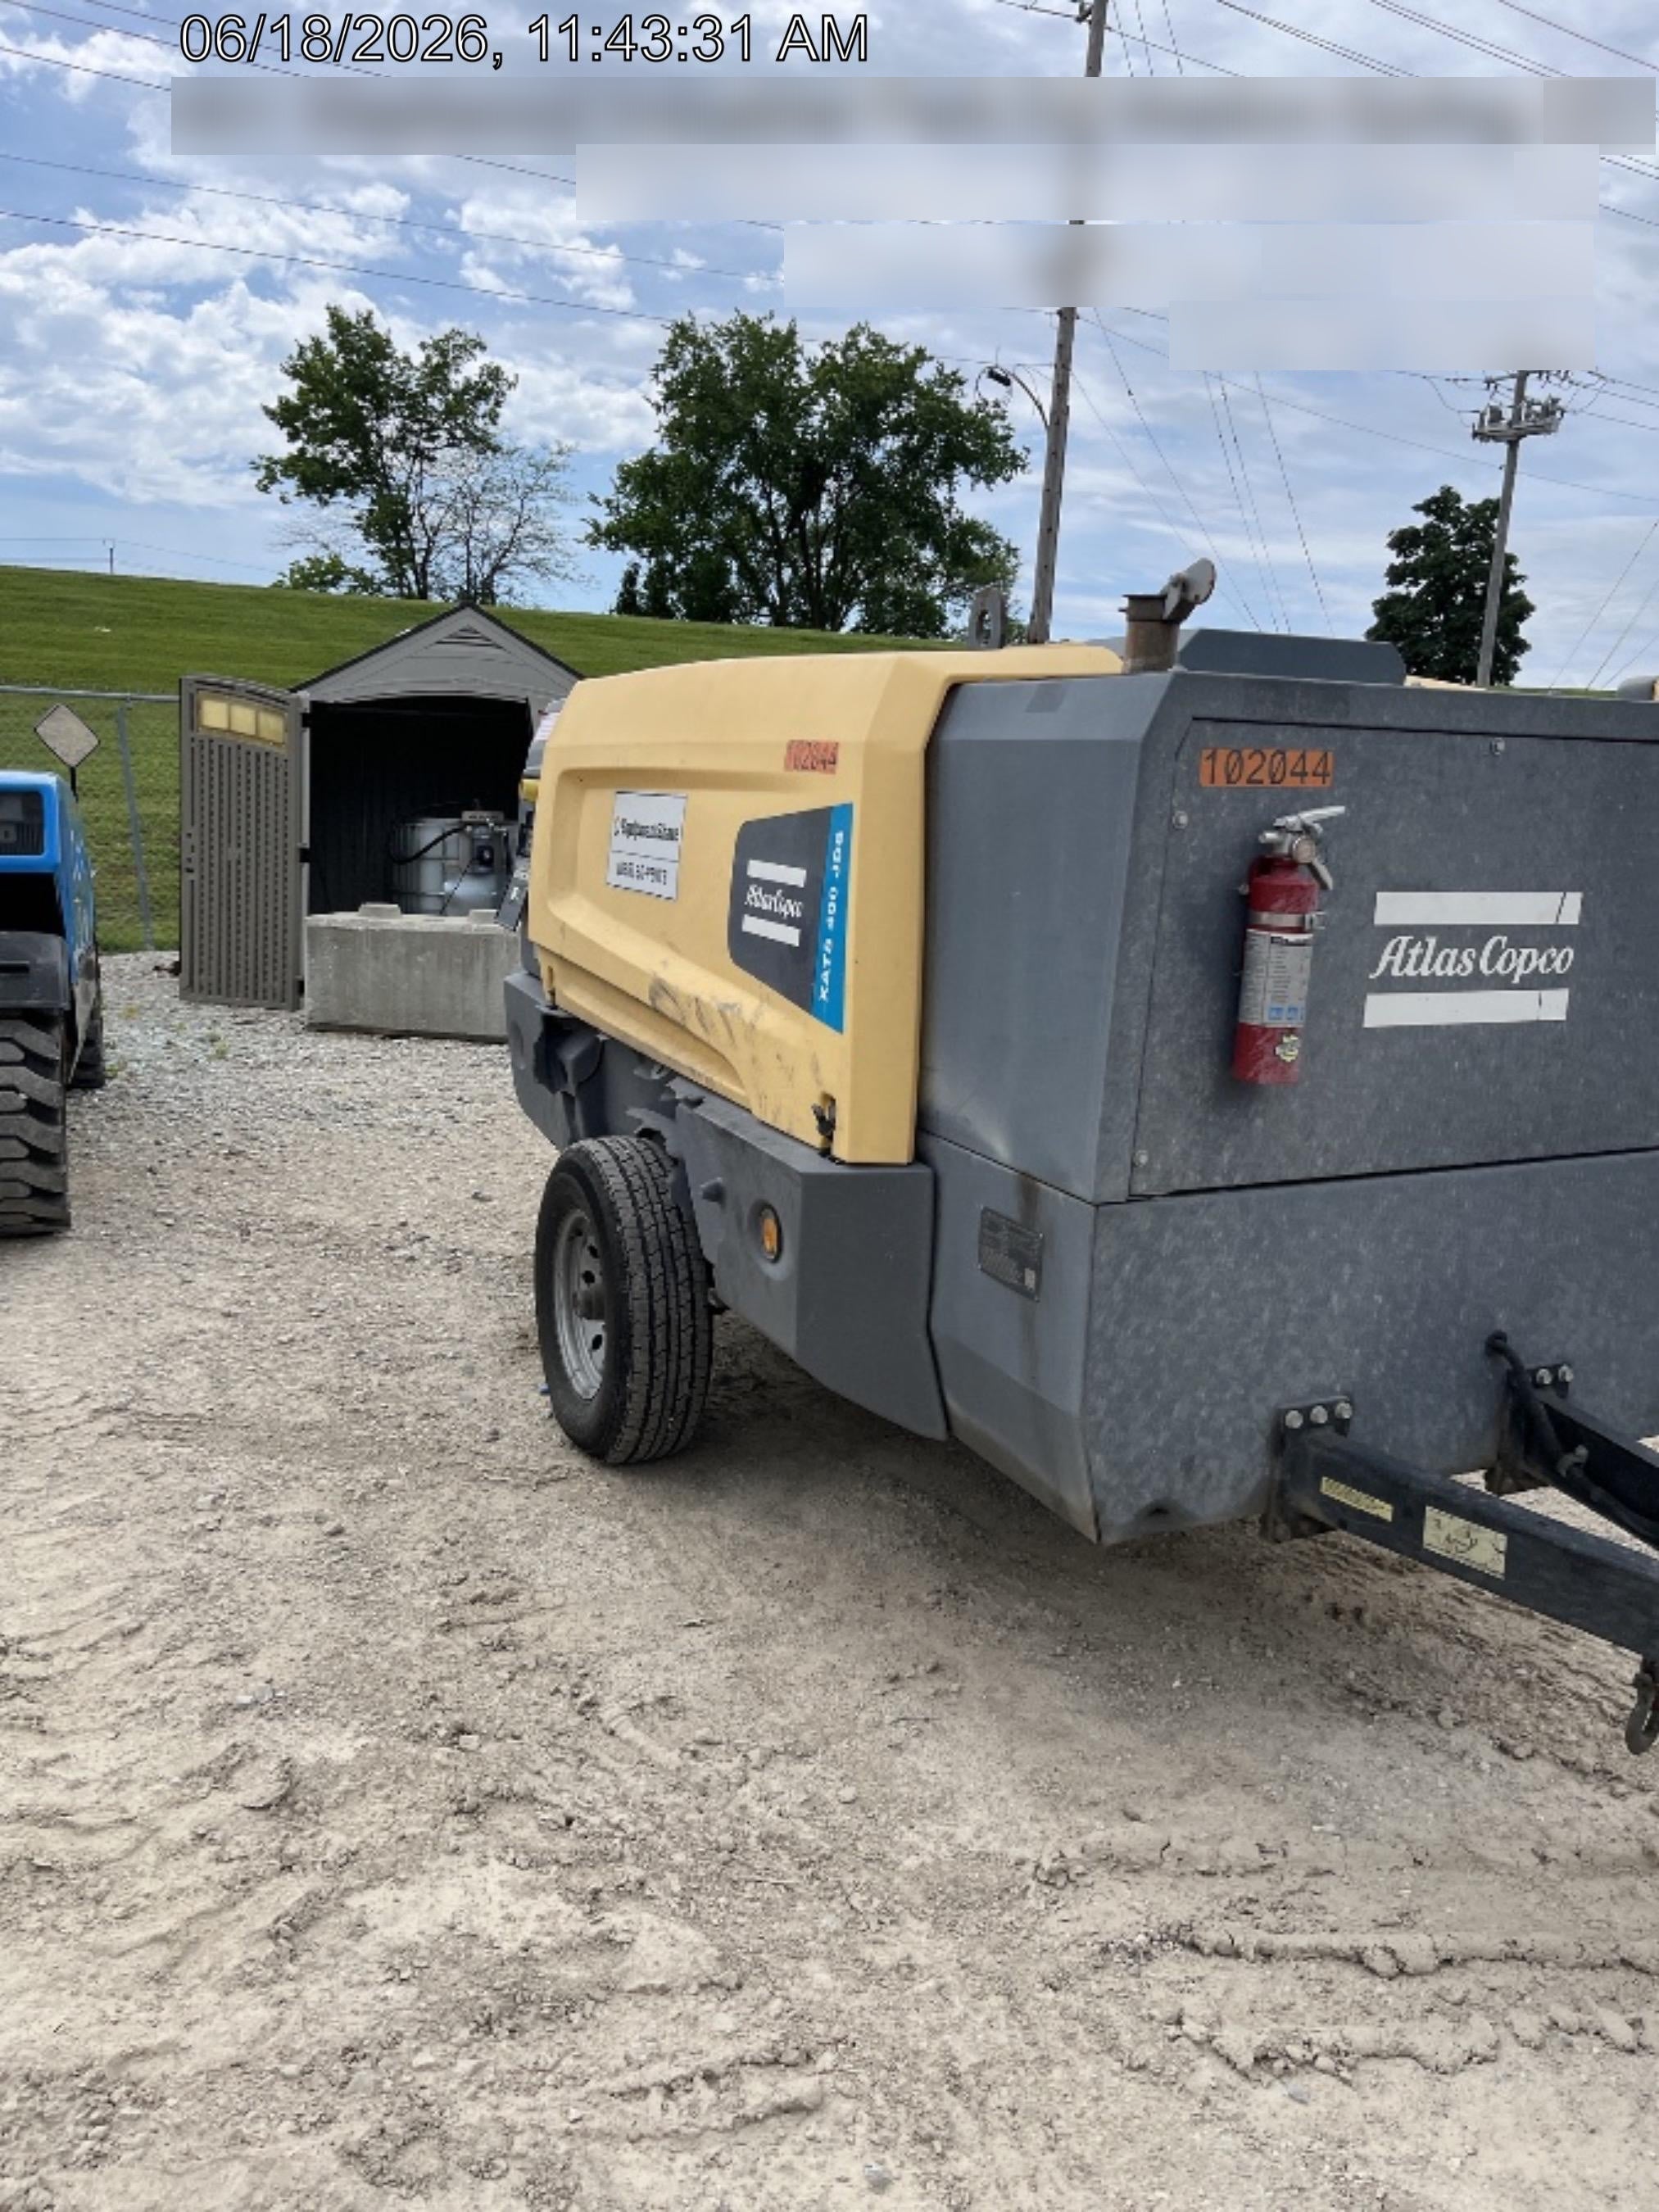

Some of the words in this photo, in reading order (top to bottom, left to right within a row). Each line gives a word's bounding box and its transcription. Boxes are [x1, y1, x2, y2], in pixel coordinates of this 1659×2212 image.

[1205, 749, 1330, 784] 102044
[826, 886, 838, 931] 400
[832, 831, 844, 878] JDS
[1368, 936, 1475, 979] Atlas
[1479, 936, 1574, 984] Copco
